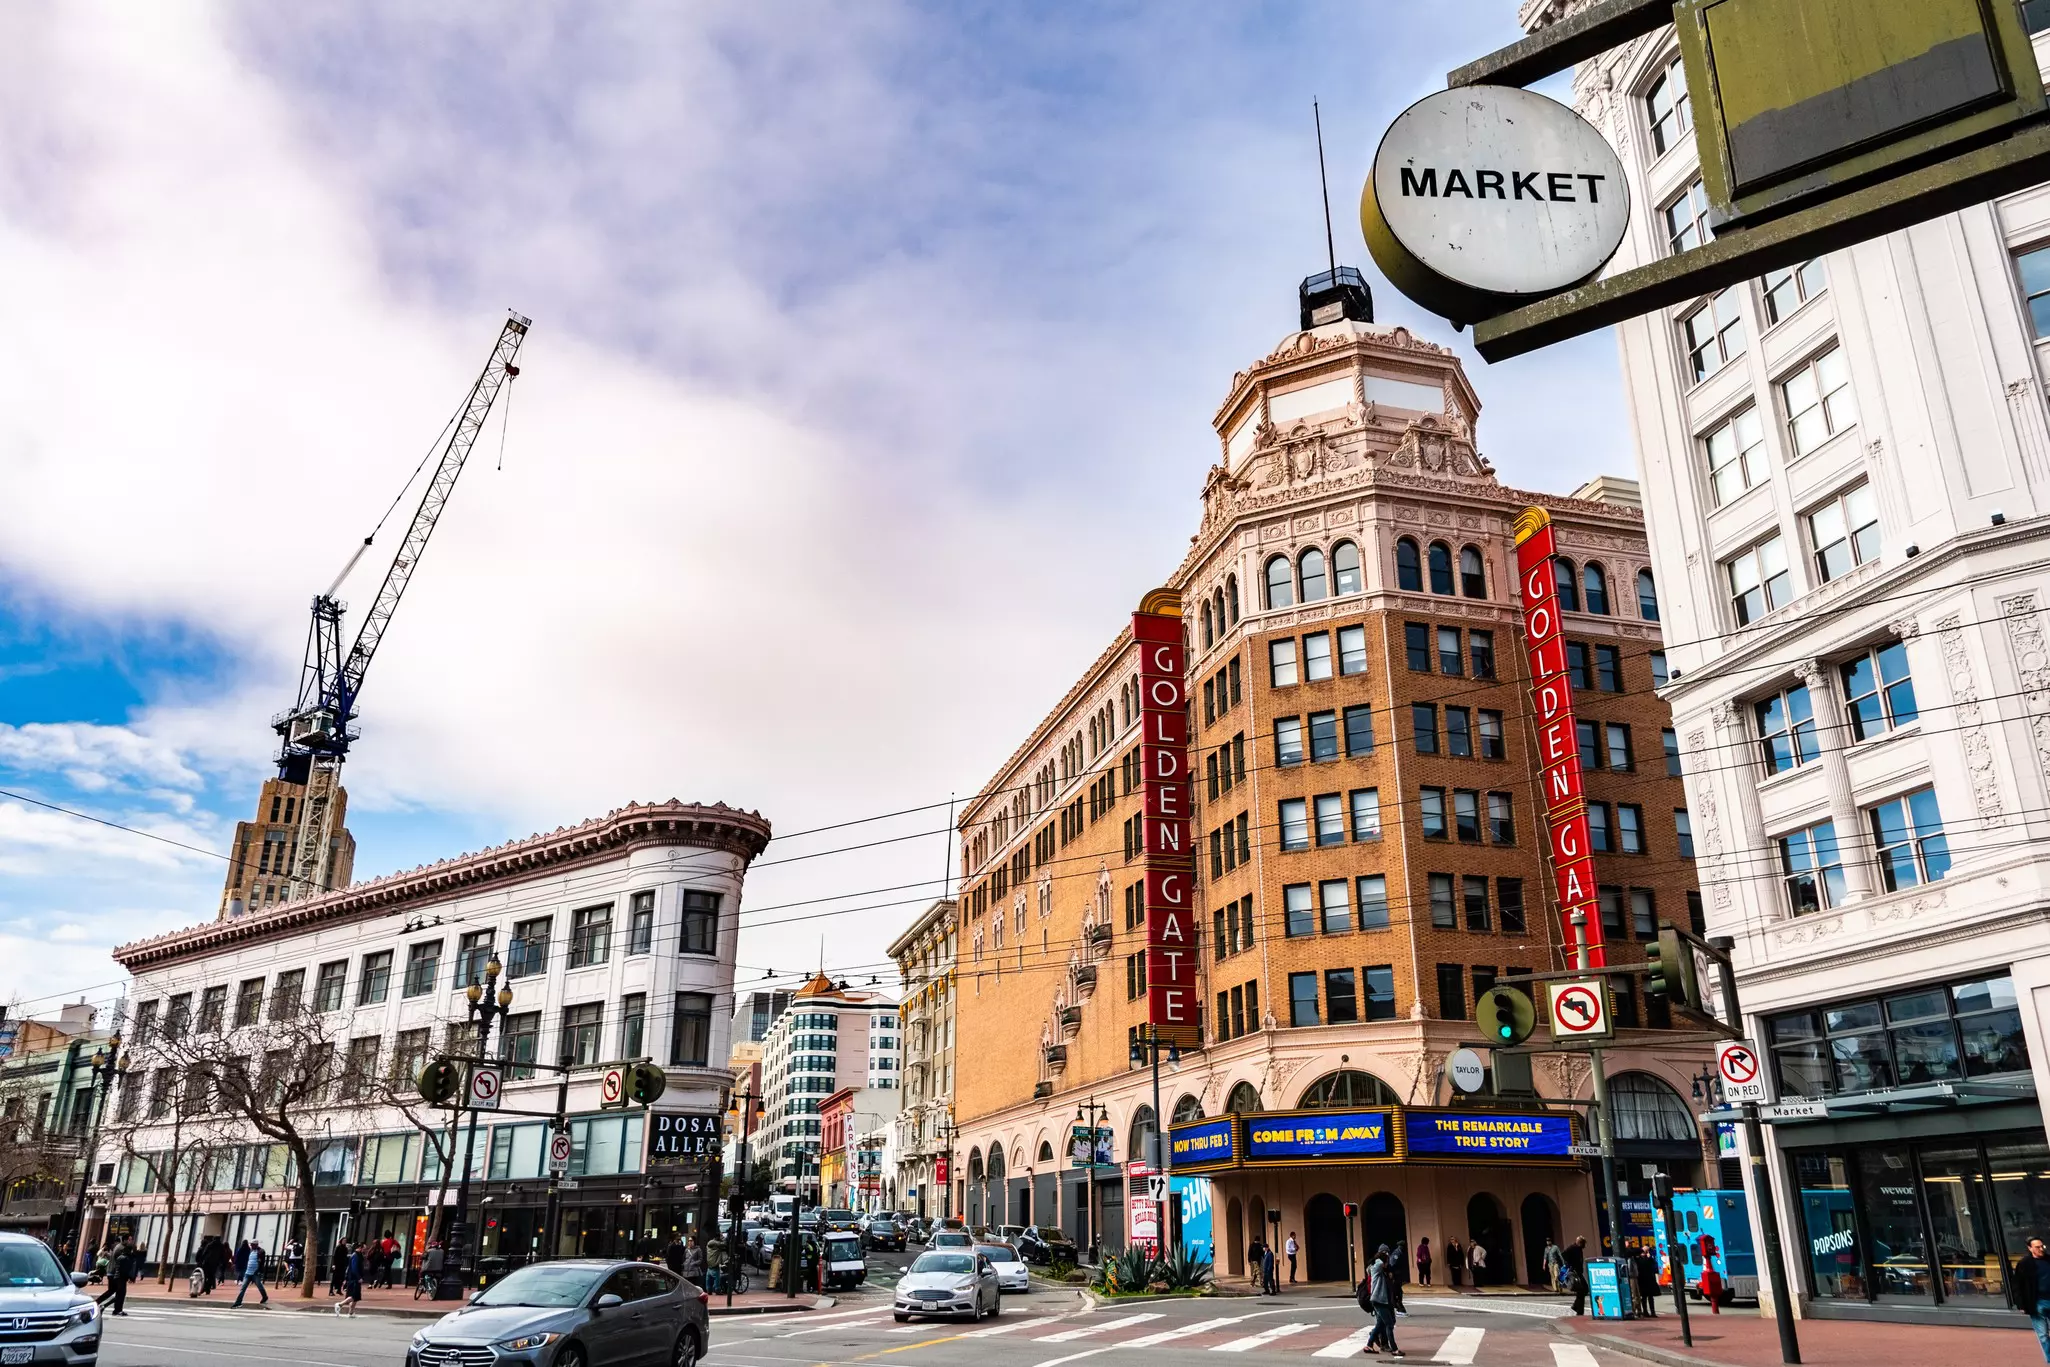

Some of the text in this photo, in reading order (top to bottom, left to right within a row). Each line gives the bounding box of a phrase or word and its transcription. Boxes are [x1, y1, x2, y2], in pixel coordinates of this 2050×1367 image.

[1400, 167, 1606, 204] MARKET
[1528, 568, 1570, 801] GOLDEN
[1151, 646, 1184, 1021] GOLDEN GATE
[1455, 1066, 1480, 1075] TAYLOR
[1728, 1085, 1760, 1097] ON RED
[1773, 1106, 1814, 1116] Market
[658, 1116, 716, 1133] DOSA
[1435, 1119, 1543, 1133] THE REMARKABLE
[1174, 1133, 1229, 1153] NOW THRU FEB 3
[1253, 1129, 1294, 1143] COME
[1340, 1126, 1382, 1140] AWAY
[1454, 1135, 1530, 1148] TRUE STORY
[846, 1115, 857, 1179] PARKING
[558, 1160, 568, 1168] RED
[1622, 1202, 1633, 1210] BEST
[1813, 1229, 1854, 1256] POPSONS
